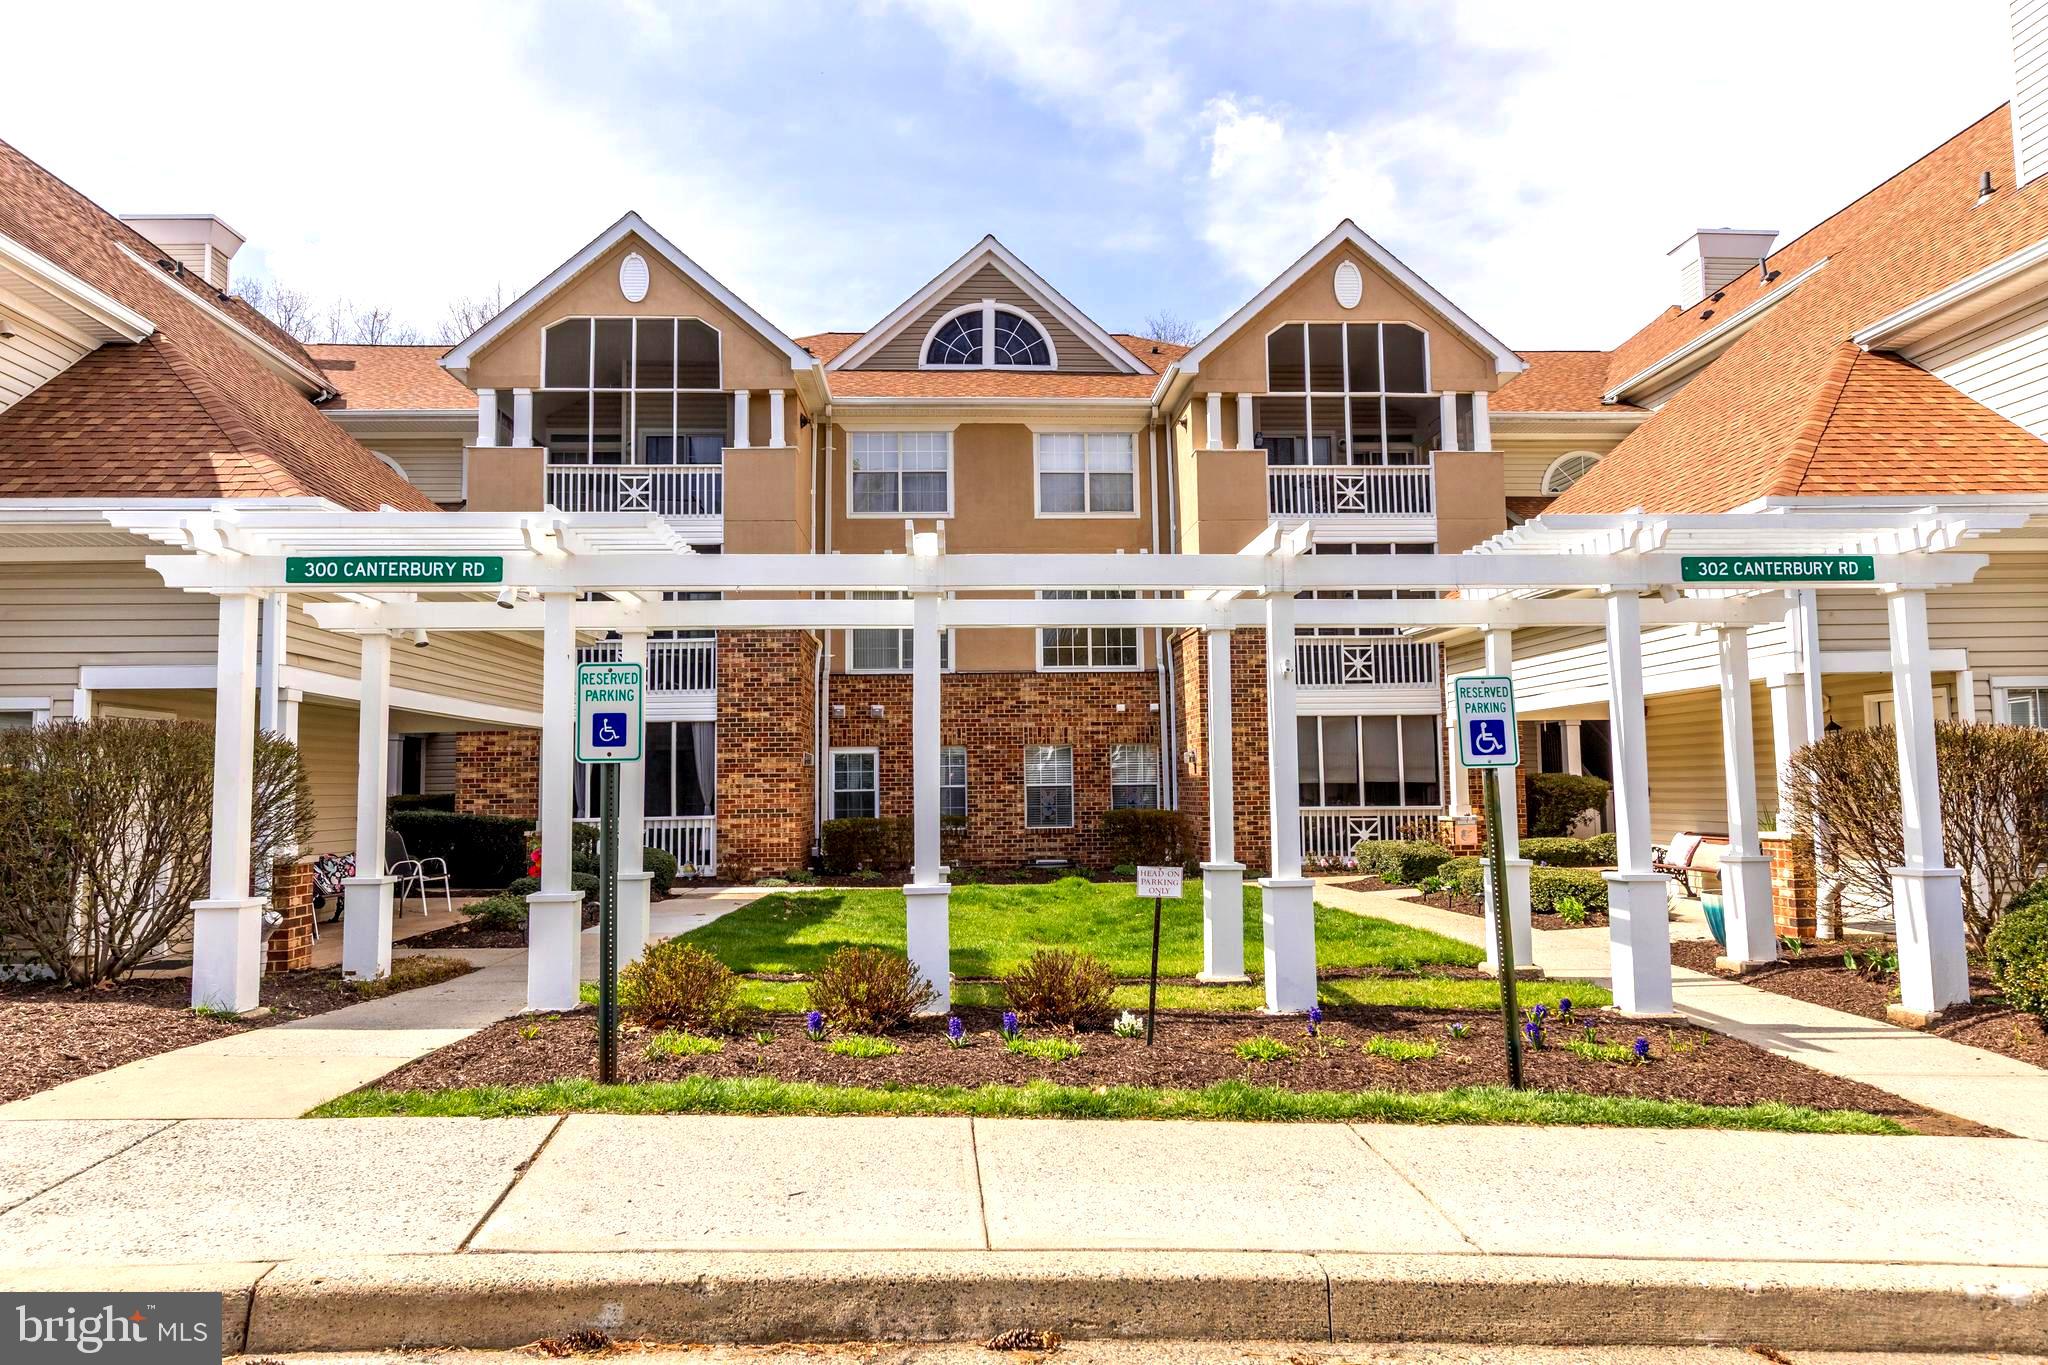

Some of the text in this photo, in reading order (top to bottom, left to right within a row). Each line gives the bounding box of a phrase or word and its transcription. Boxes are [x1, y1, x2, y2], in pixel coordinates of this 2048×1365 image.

[304, 561, 485, 577] 300 CANTERBURY RD
[1698, 561, 1859, 576] 302 CANTERBURY RD
[581, 672, 639, 685] RESERVED
[585, 689, 635, 702] PARKING
[1460, 686, 1509, 698] RESERVED
[1464, 702, 1507, 713] PARKING
[1141, 878, 1179, 886] PARKING
[1148, 887, 1169, 895] ONLY
